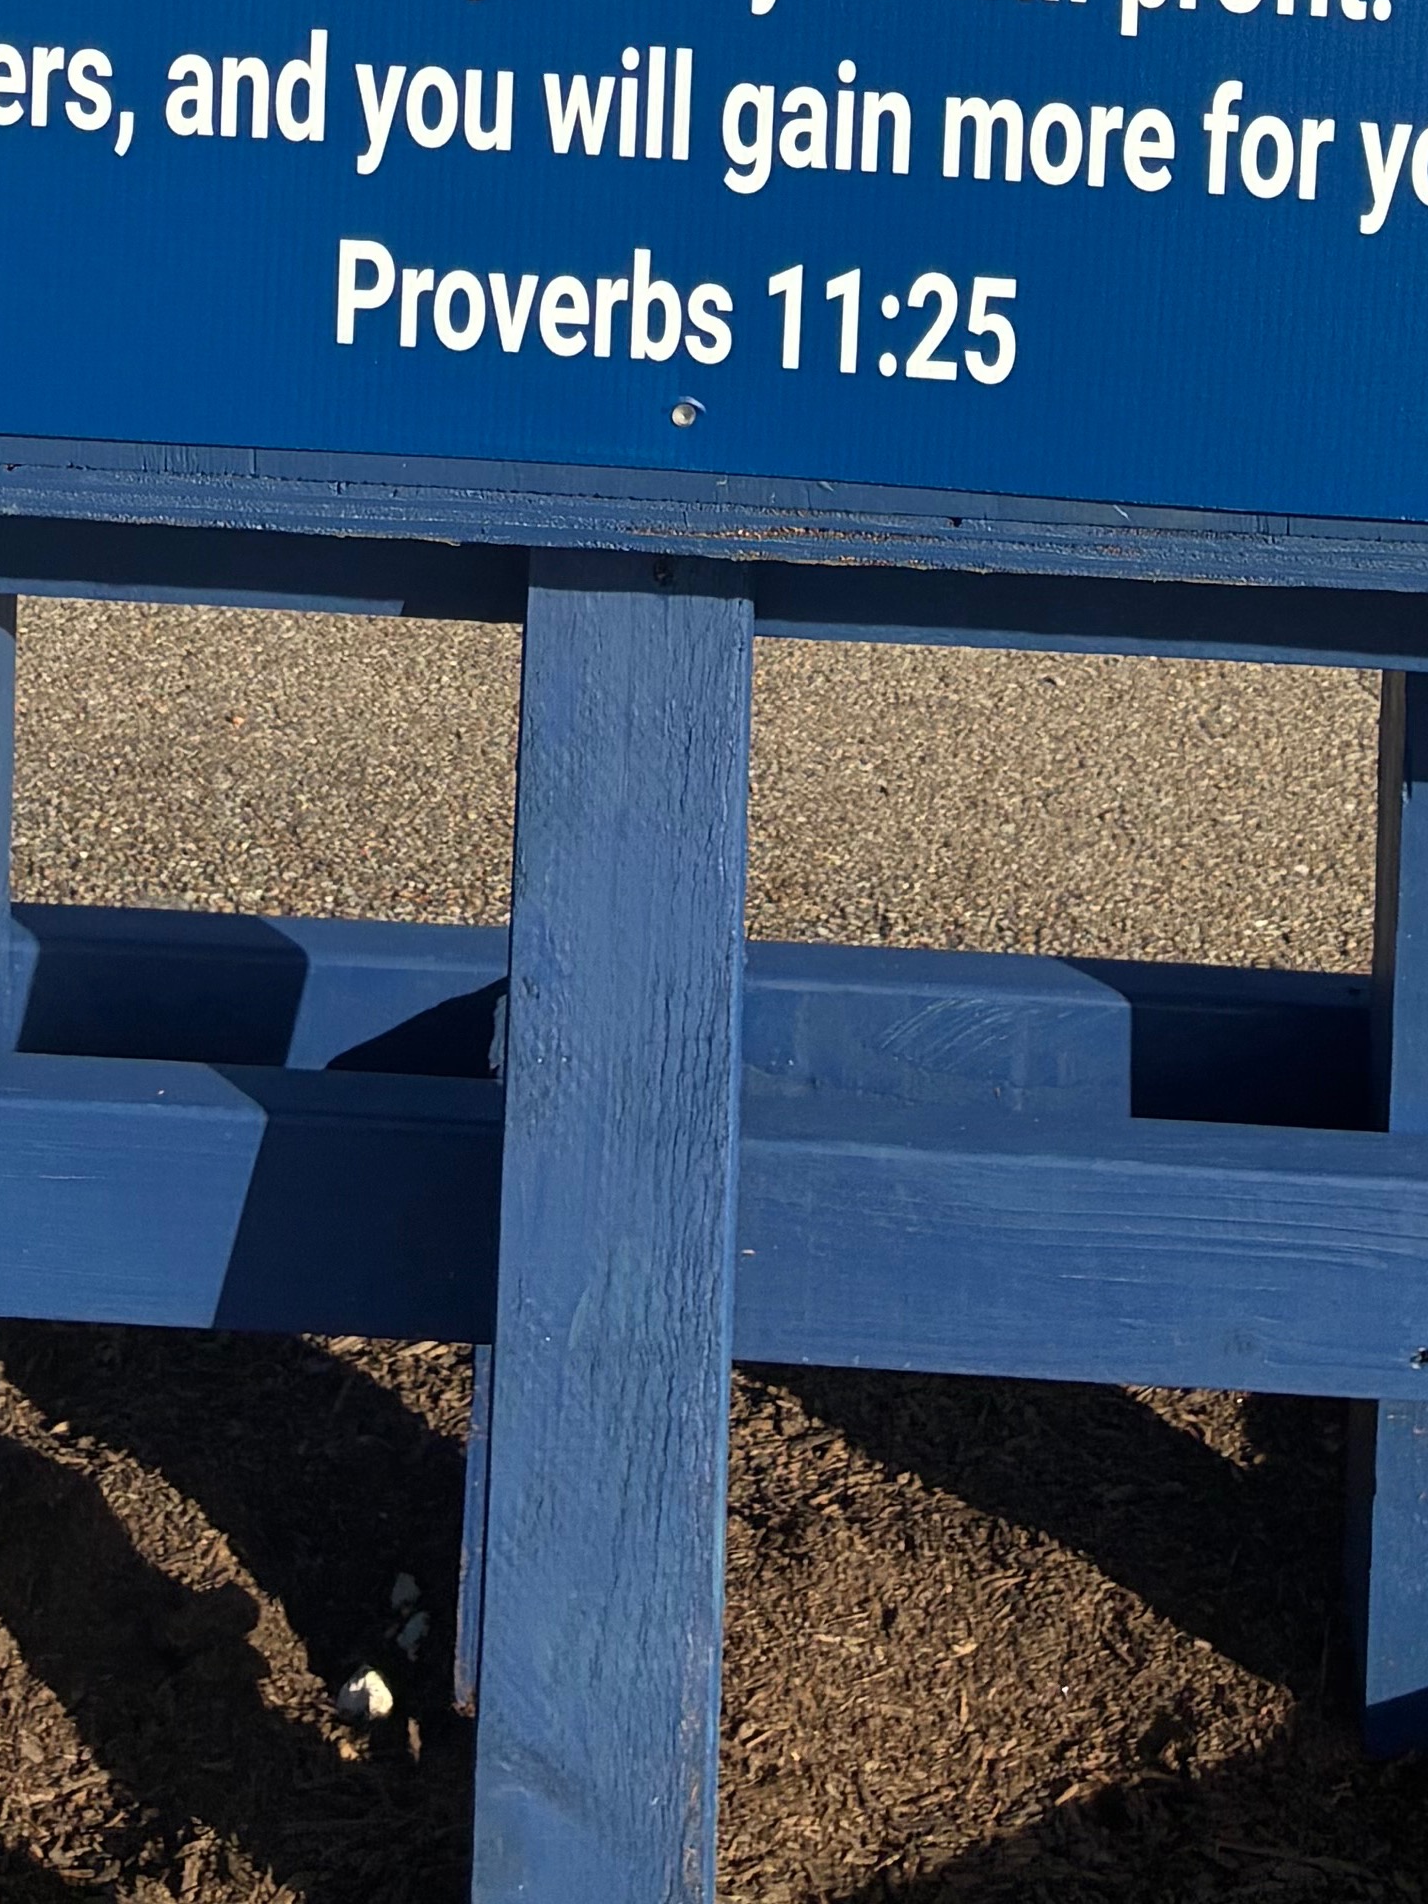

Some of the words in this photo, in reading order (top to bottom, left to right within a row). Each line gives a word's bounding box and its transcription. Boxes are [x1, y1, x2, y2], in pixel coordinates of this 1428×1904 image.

[166, 29, 327, 141] and
[356, 64, 513, 174] you
[544, 47, 692, 160] will
[723, 60, 911, 193] gain
[943, 97, 1174, 191] more
[1204, 81, 1335, 199] for
[337, 239, 732, 365] Proverbs
[769, 265, 1016, 384] 11:25
